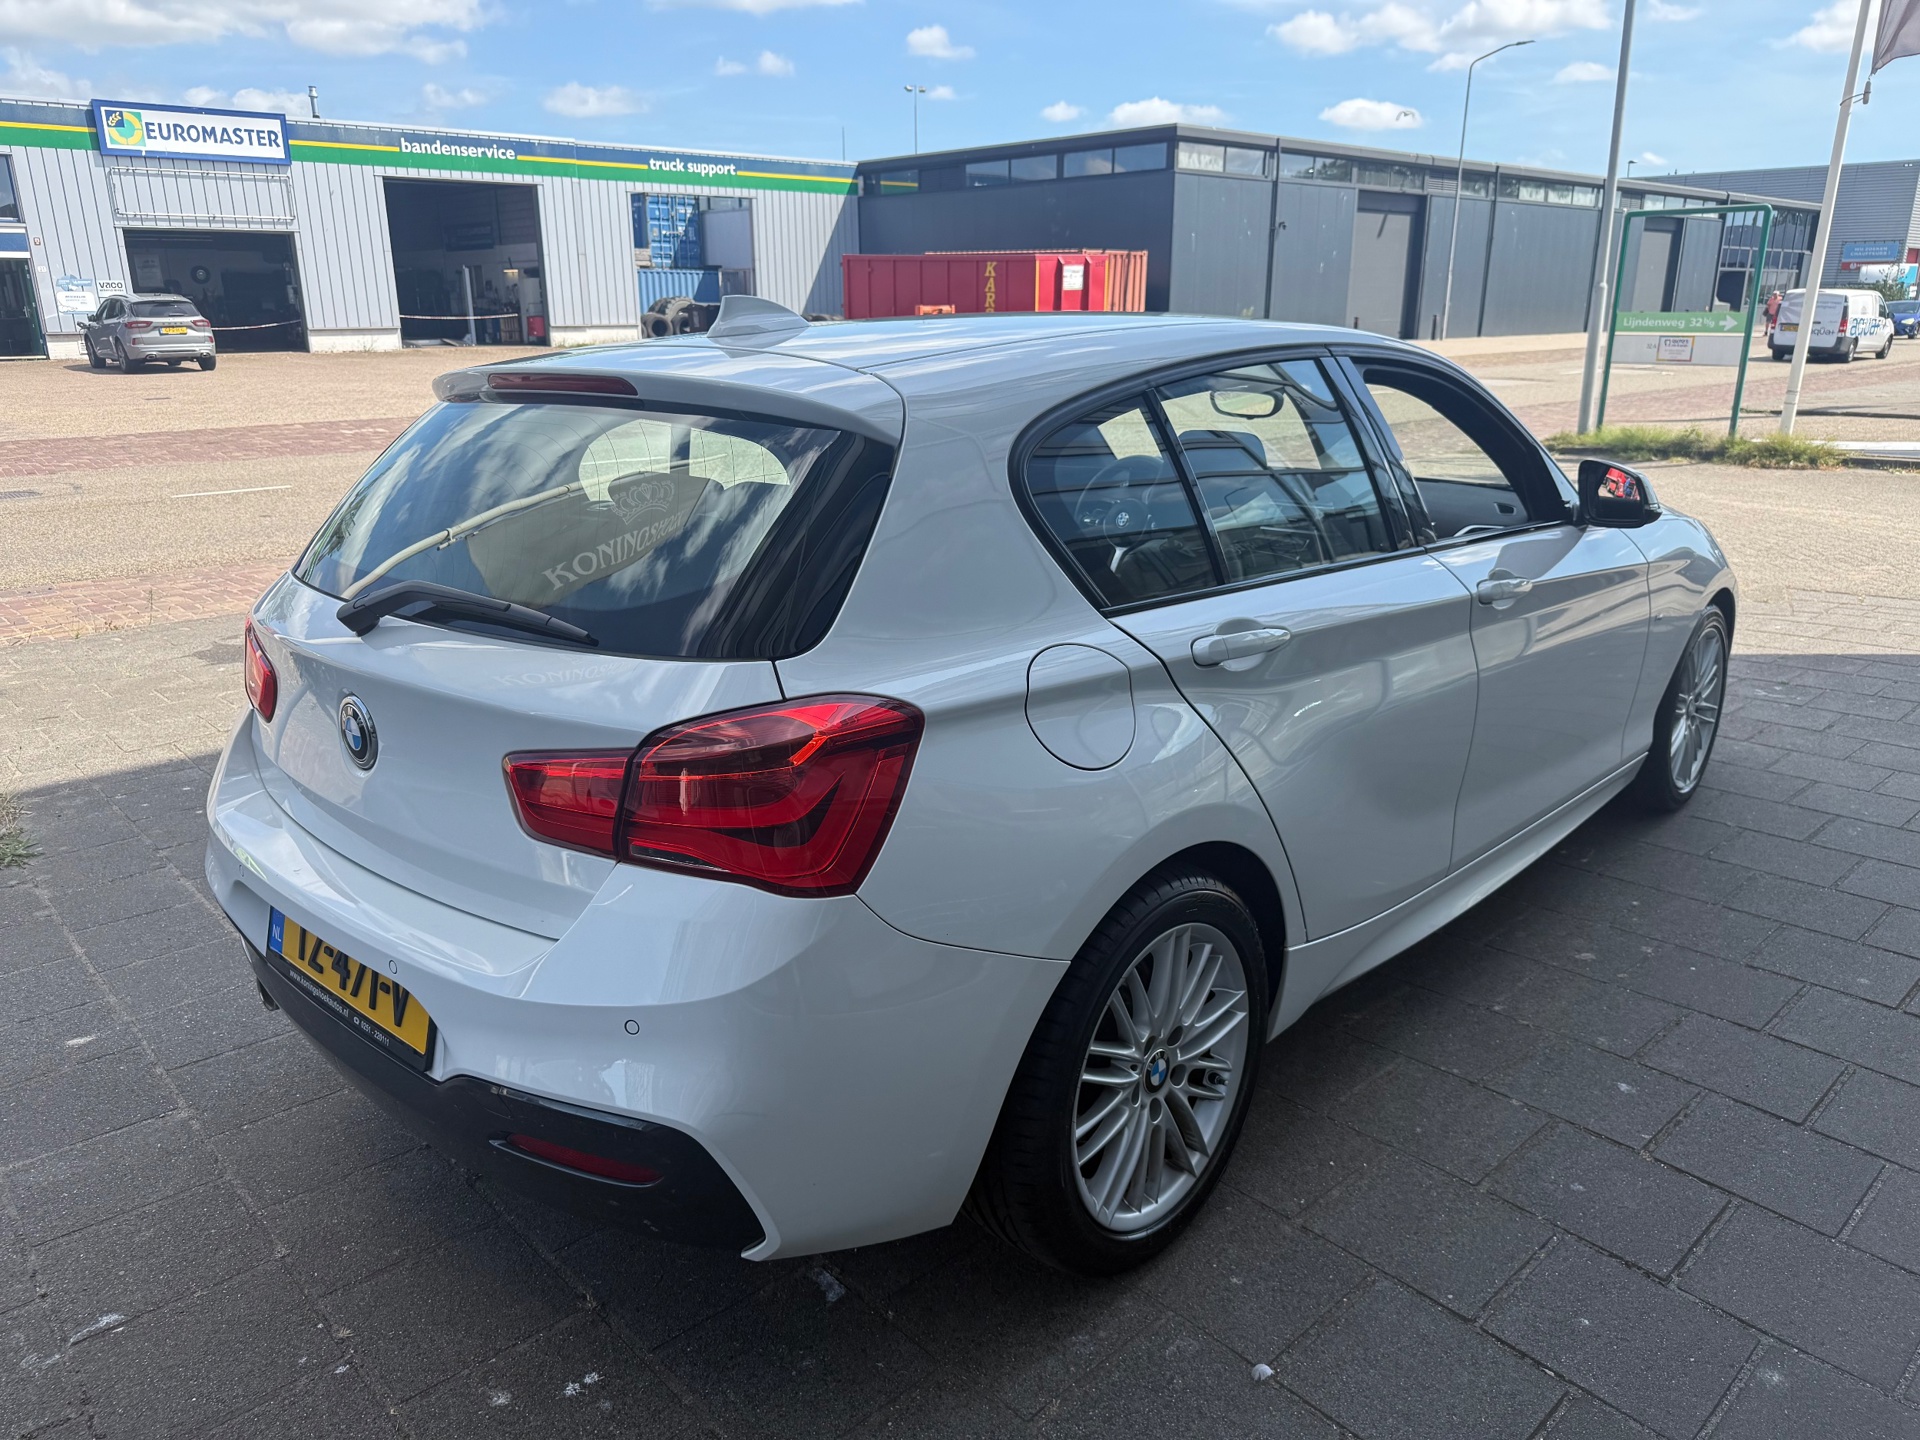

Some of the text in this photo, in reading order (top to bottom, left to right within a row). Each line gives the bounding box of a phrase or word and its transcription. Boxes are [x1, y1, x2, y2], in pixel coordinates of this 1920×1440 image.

[145, 121, 280, 149] EUROMASTER
[400, 137, 516, 161] bandenservice
[649, 157, 737, 178] truck support
[984, 261, 998, 313] KAR
[1623, 317, 1686, 329] Lijndenweg
[272, 923, 282, 942] NL
